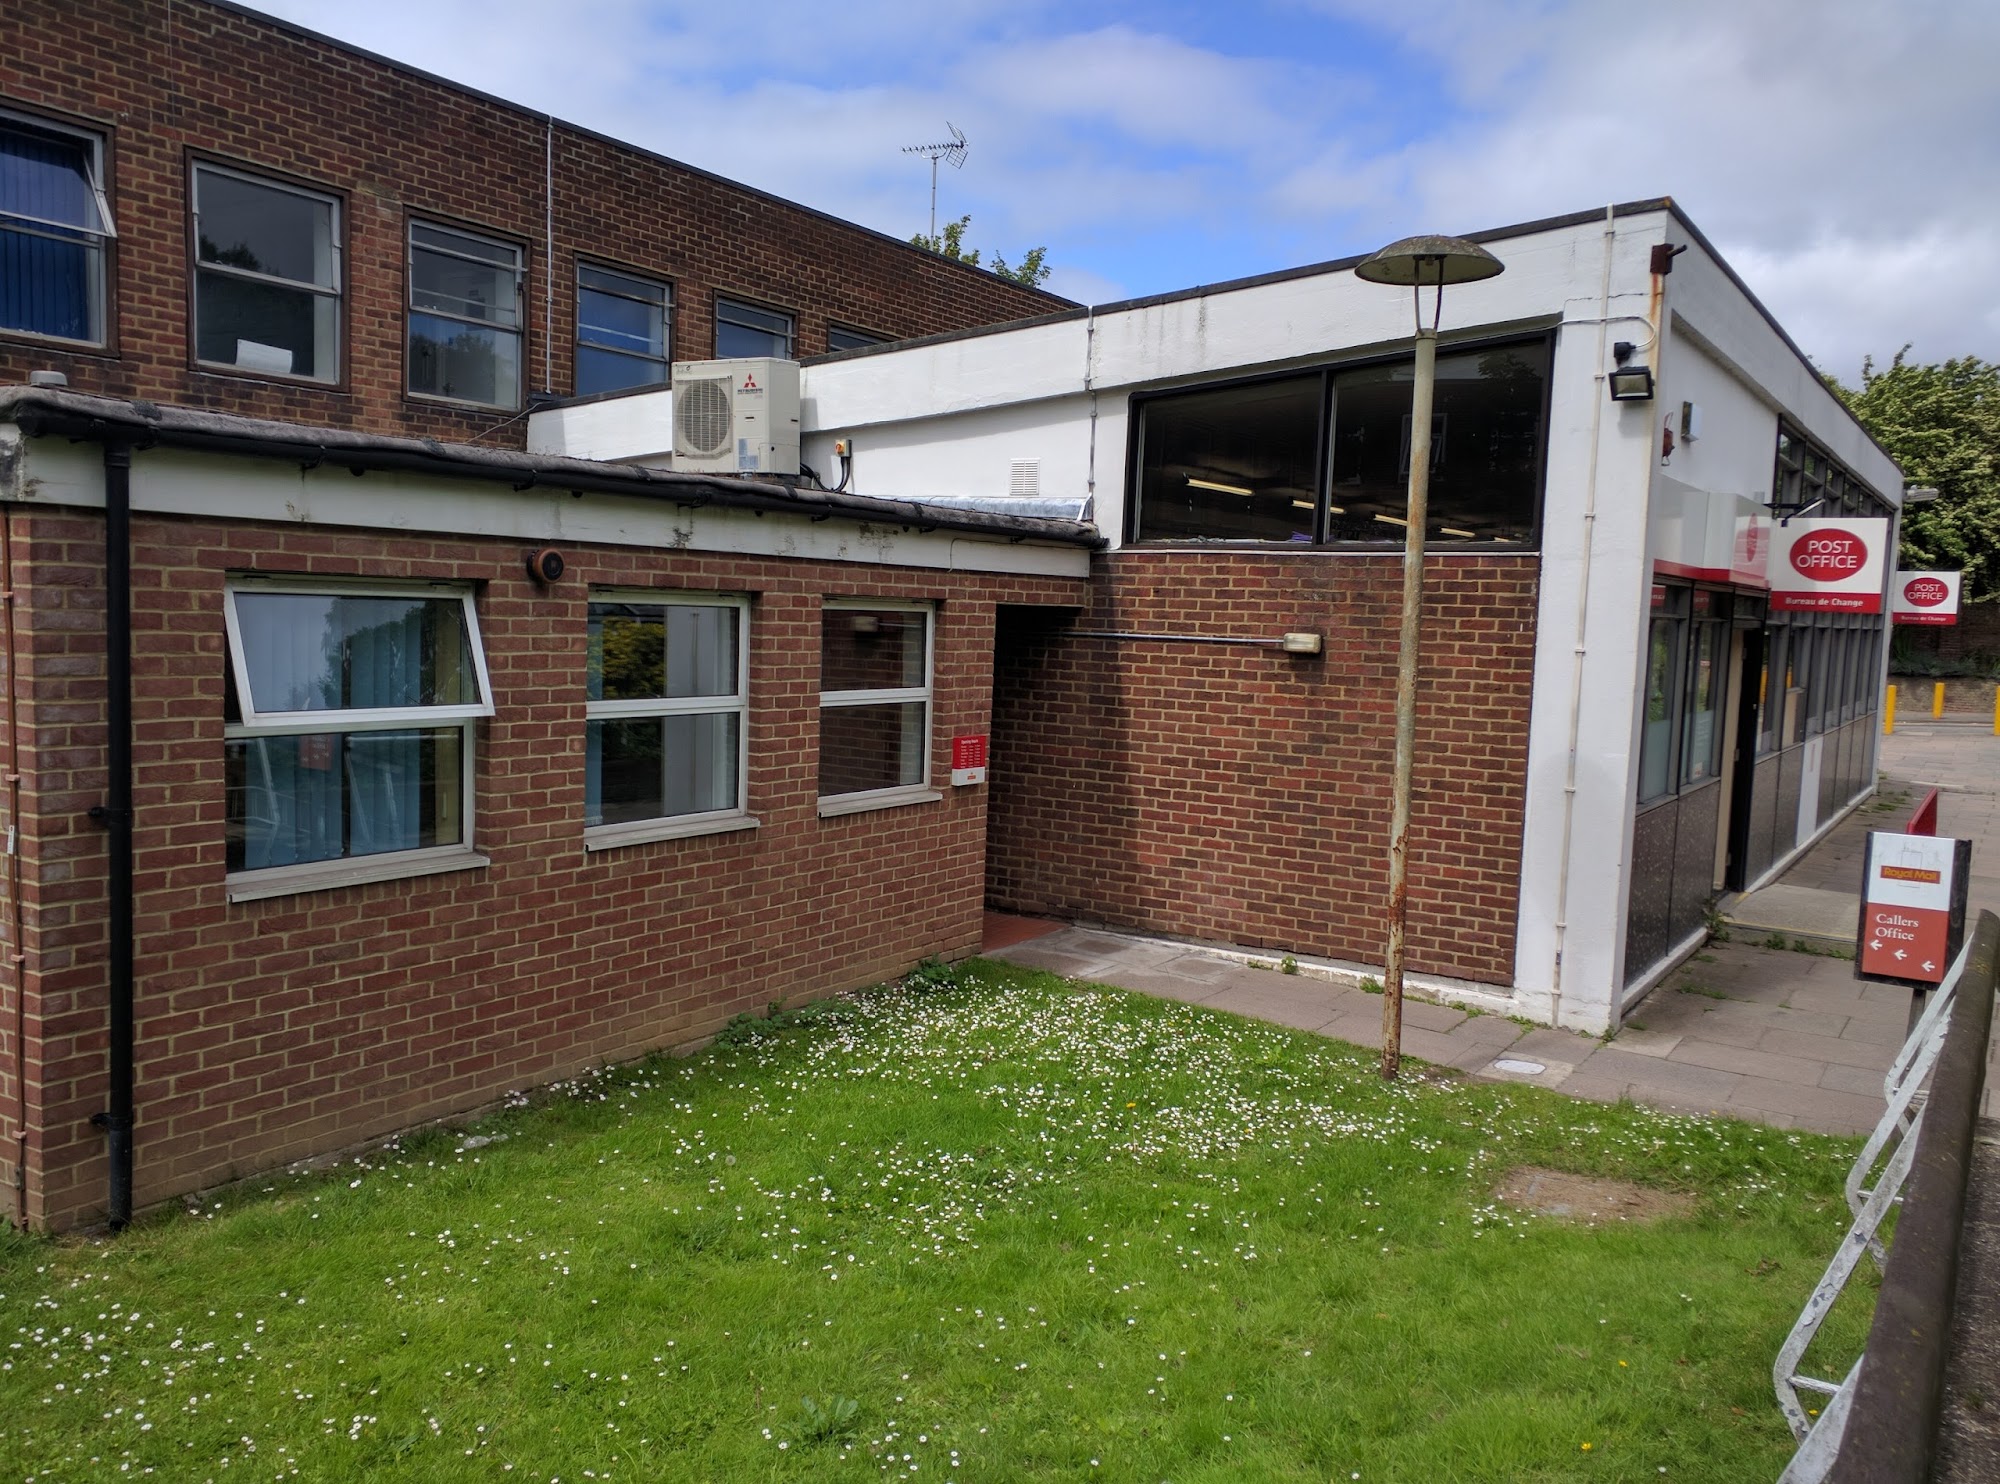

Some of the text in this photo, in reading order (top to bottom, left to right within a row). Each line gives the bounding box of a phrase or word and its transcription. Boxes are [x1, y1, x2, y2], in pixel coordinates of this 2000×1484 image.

[1808, 540, 1853, 553] POST
[1797, 554, 1858, 568] OFFICE
[1914, 583, 1941, 592] POST
[1785, 597, 1816, 605] Bureau
[1831, 598, 1864, 607] Change
[1908, 592, 1943, 600] OFFICE
[1884, 867, 1937, 880] Royal Mail
[1876, 913, 1919, 928] Callers
[1875, 927, 1915, 941] Office
